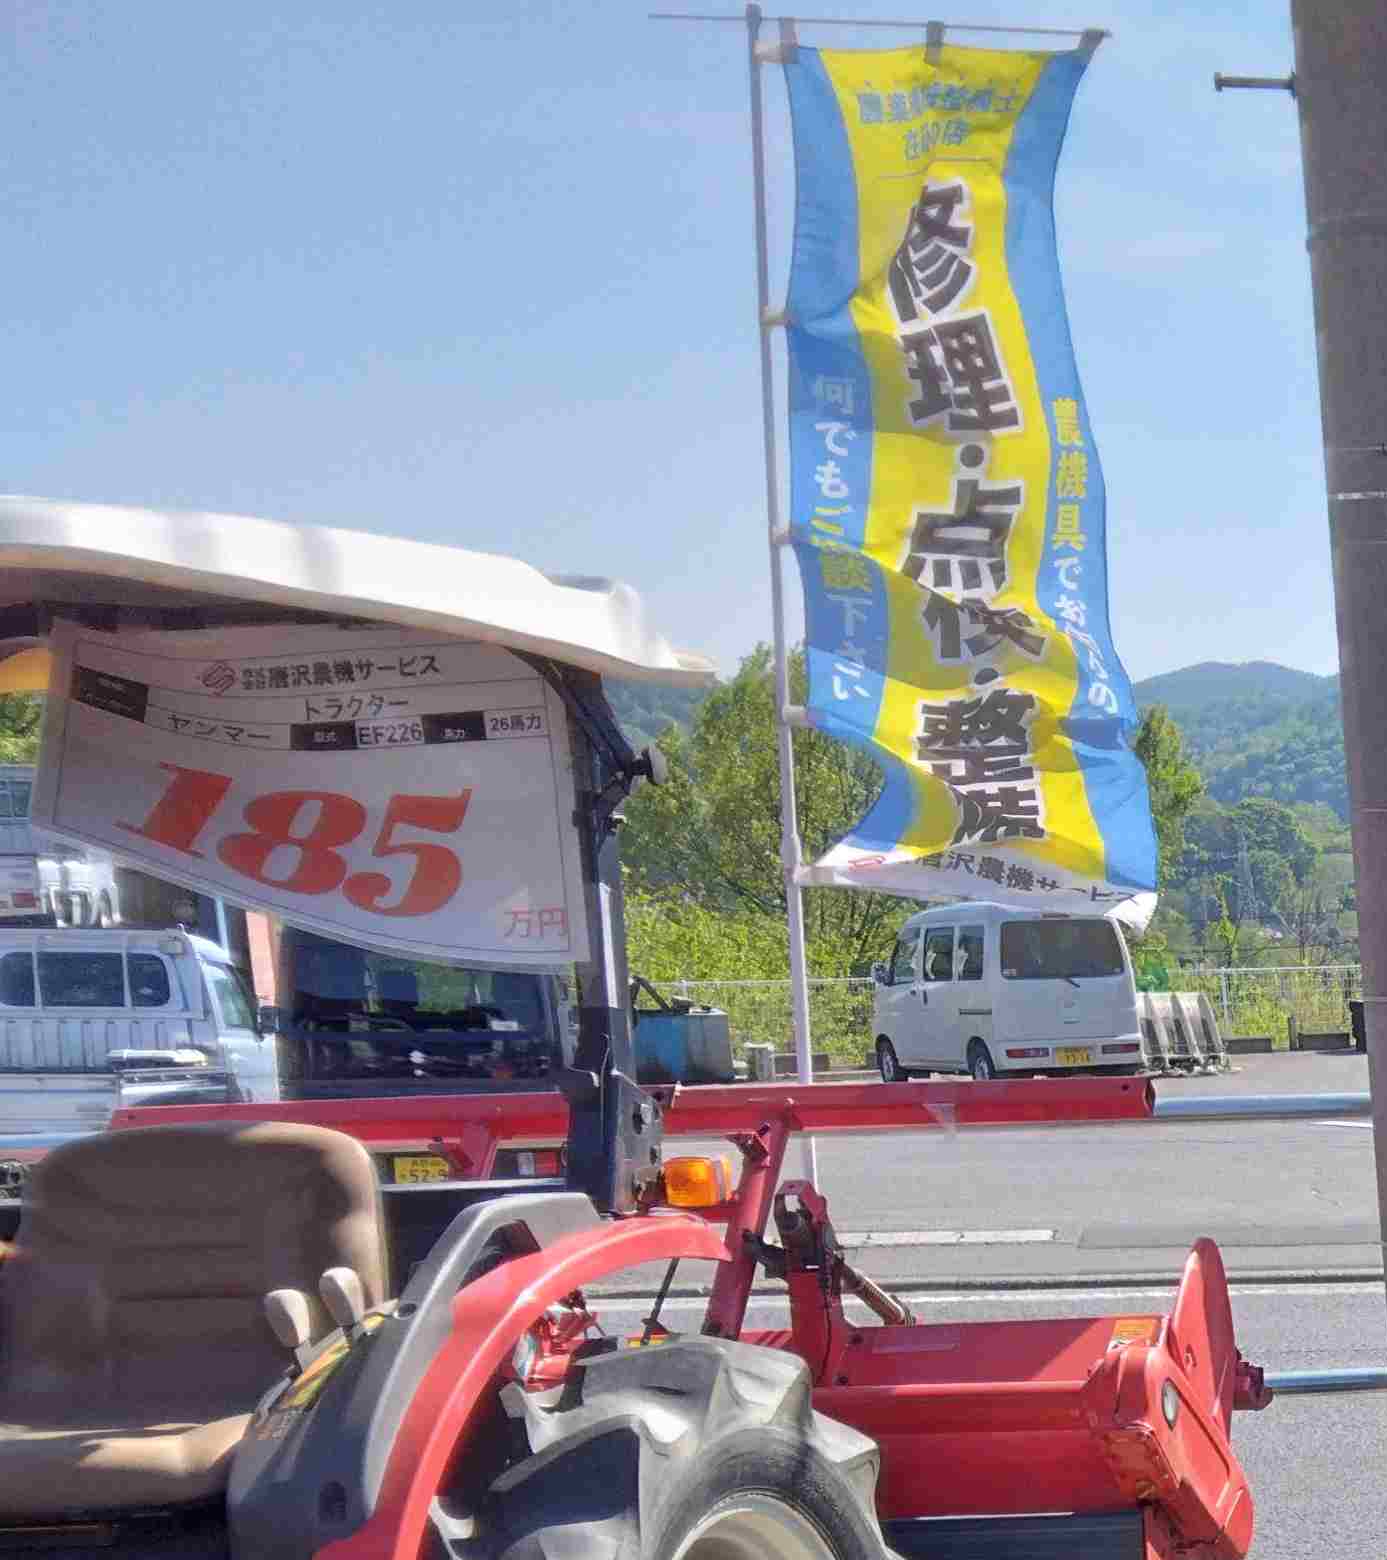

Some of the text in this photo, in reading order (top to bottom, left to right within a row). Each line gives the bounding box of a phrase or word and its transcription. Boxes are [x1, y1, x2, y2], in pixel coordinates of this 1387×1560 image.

[304, 694, 409, 720] トラクター
[167, 713, 271, 742] ヤンマー
[358, 722, 423, 745] EF226
[112, 760, 472, 917] 185
[504, 908, 568, 938] 万円
